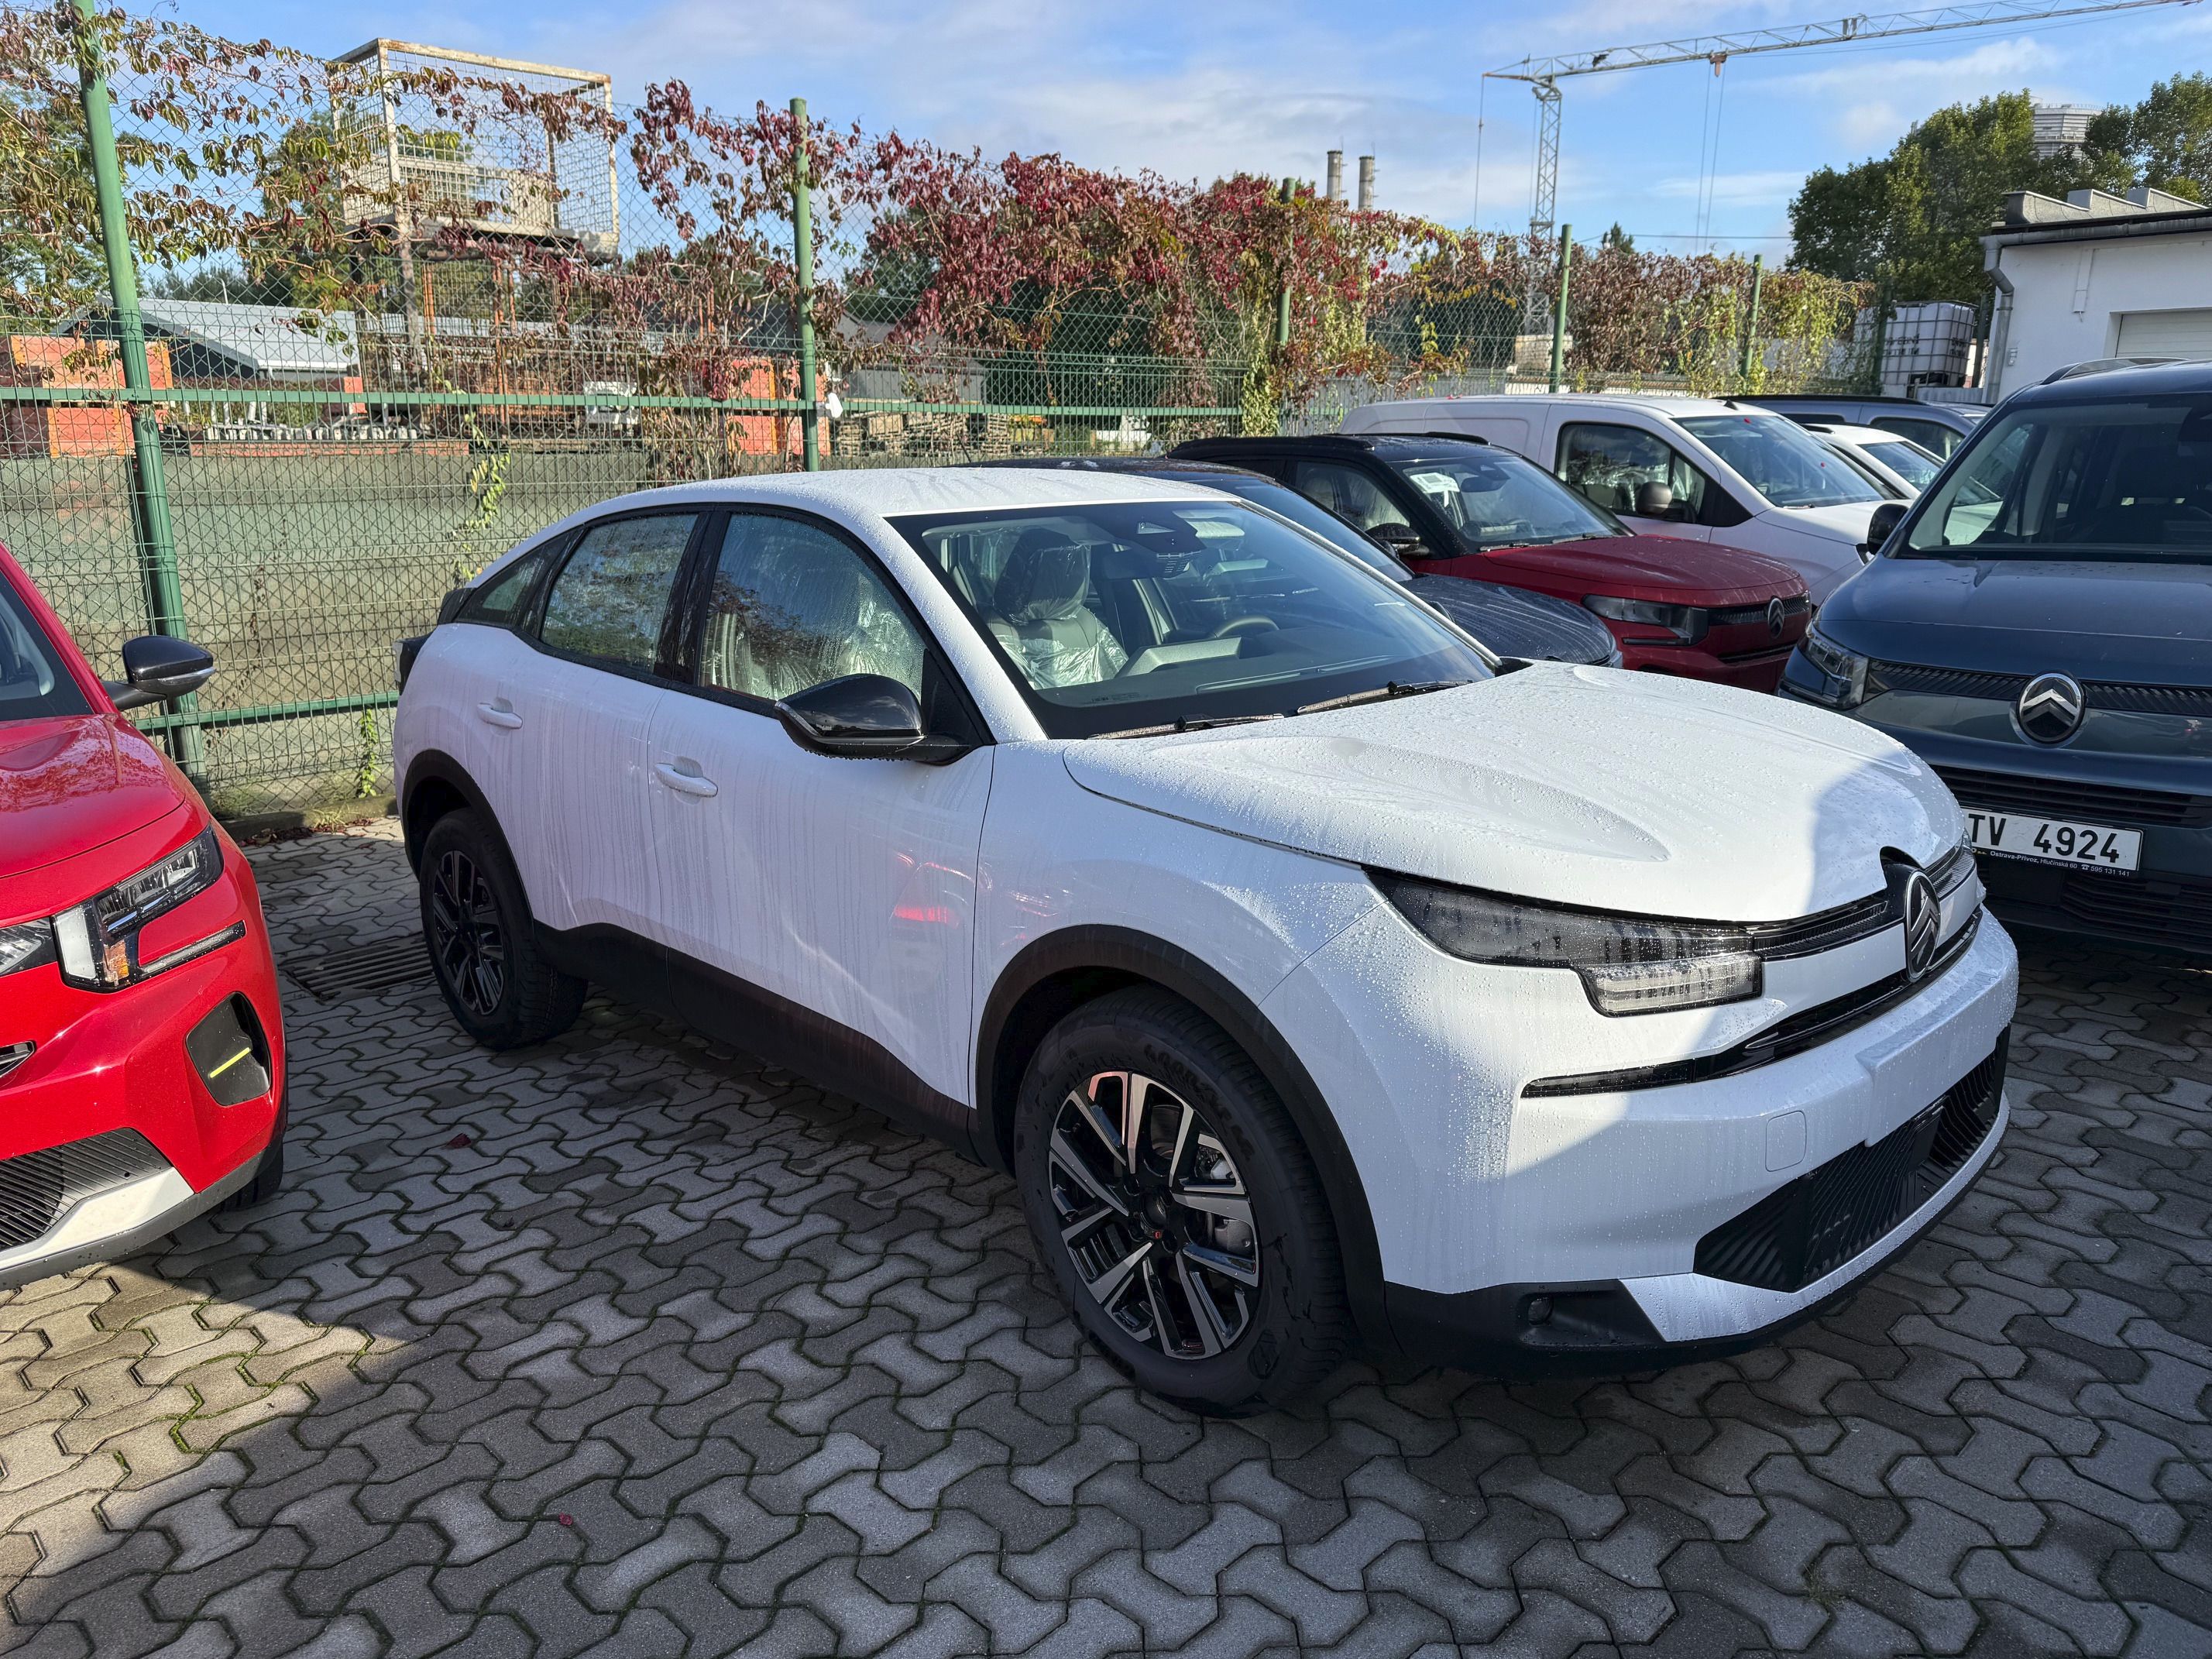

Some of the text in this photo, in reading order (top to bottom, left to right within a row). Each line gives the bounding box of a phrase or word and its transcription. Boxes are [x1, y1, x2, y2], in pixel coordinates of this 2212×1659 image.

[1968, 813, 2120, 864] TV 4924
[1990, 850, 2039, 864] Ostrava-Přívoz,
[2040, 857, 2069, 868] Hlučínská
